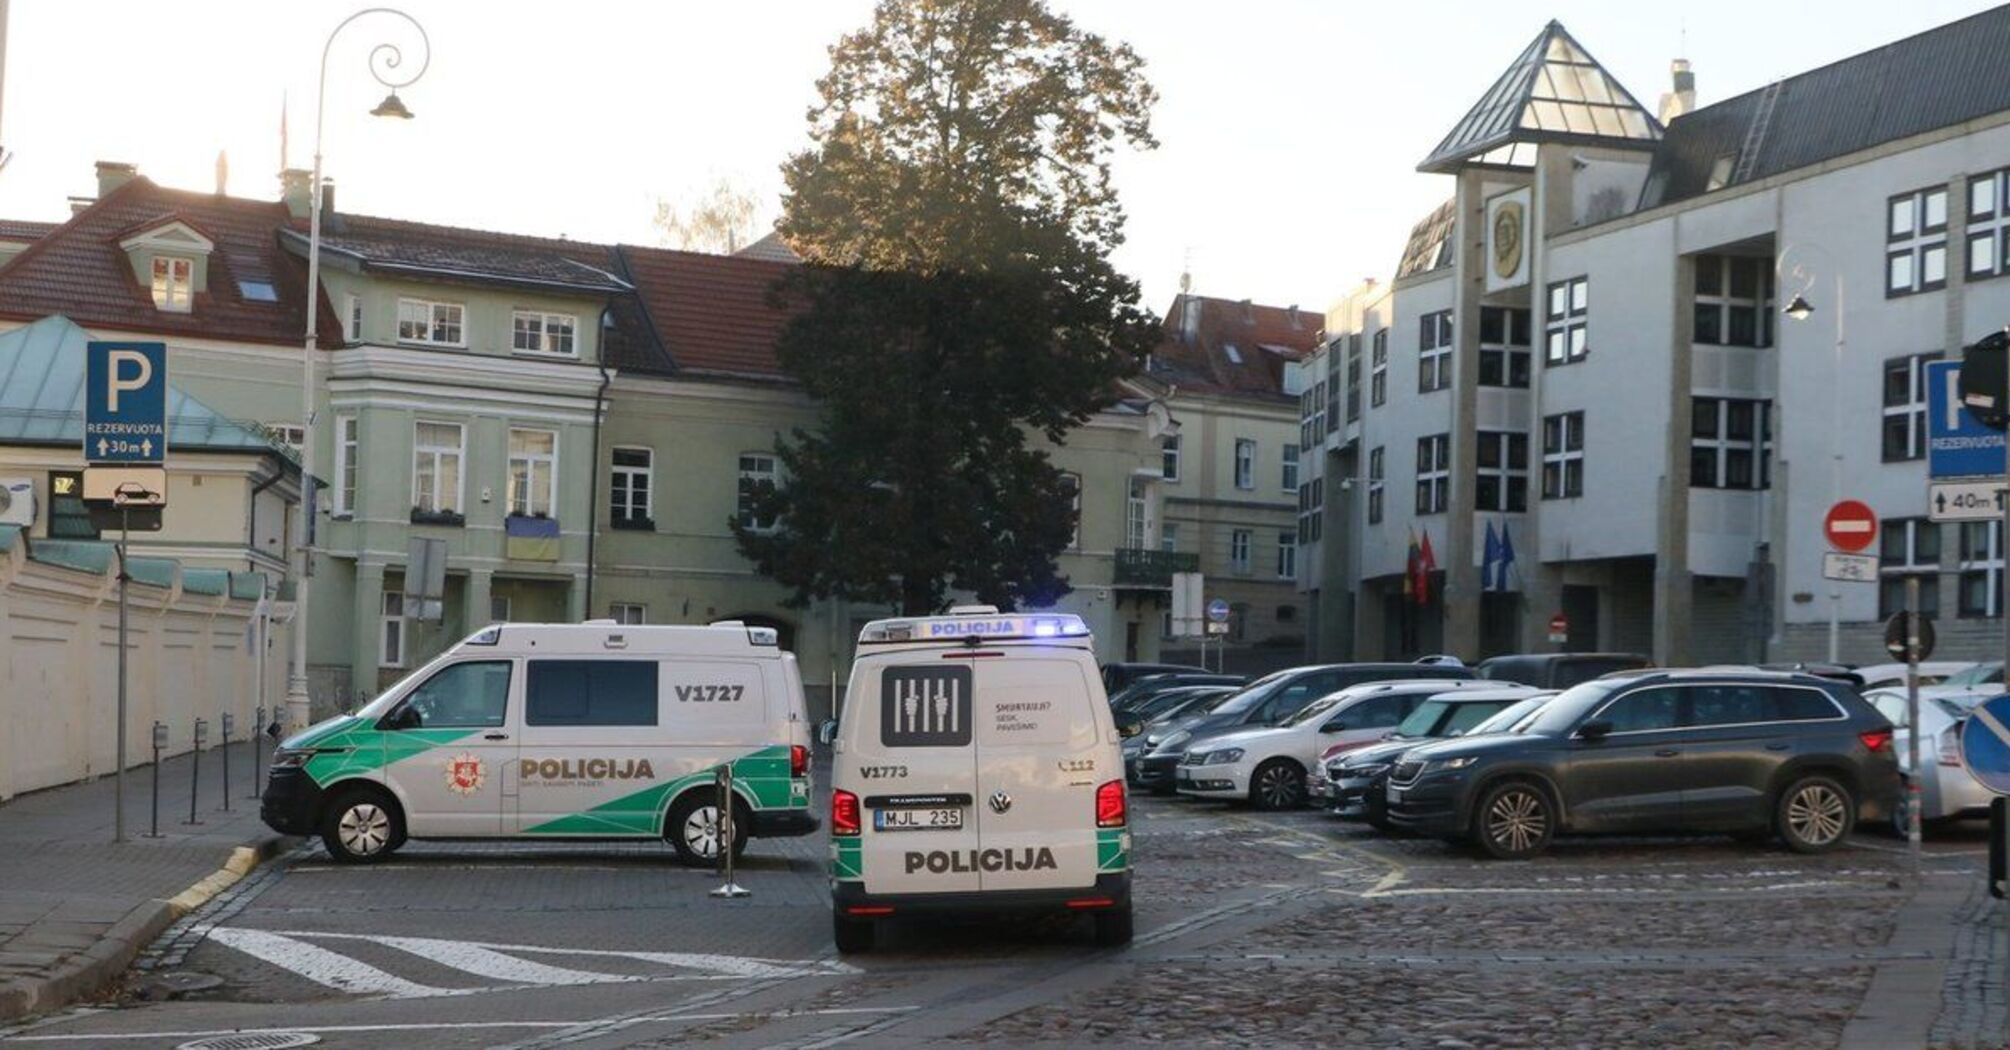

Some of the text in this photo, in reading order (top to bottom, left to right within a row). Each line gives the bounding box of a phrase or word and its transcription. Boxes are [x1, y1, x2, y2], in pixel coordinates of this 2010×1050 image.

[107, 350, 152, 413] P
[87, 423, 163, 435] REZERVUOTA
[931, 620, 1014, 636] POLICIJA
[674, 685, 745, 702] V1727
[520, 758, 656, 780] POLICIJA
[860, 765, 908, 779] V1773
[885, 811, 919, 826] MJL
[930, 810, 959, 825] 235
[905, 847, 1058, 874] POLICIJA
